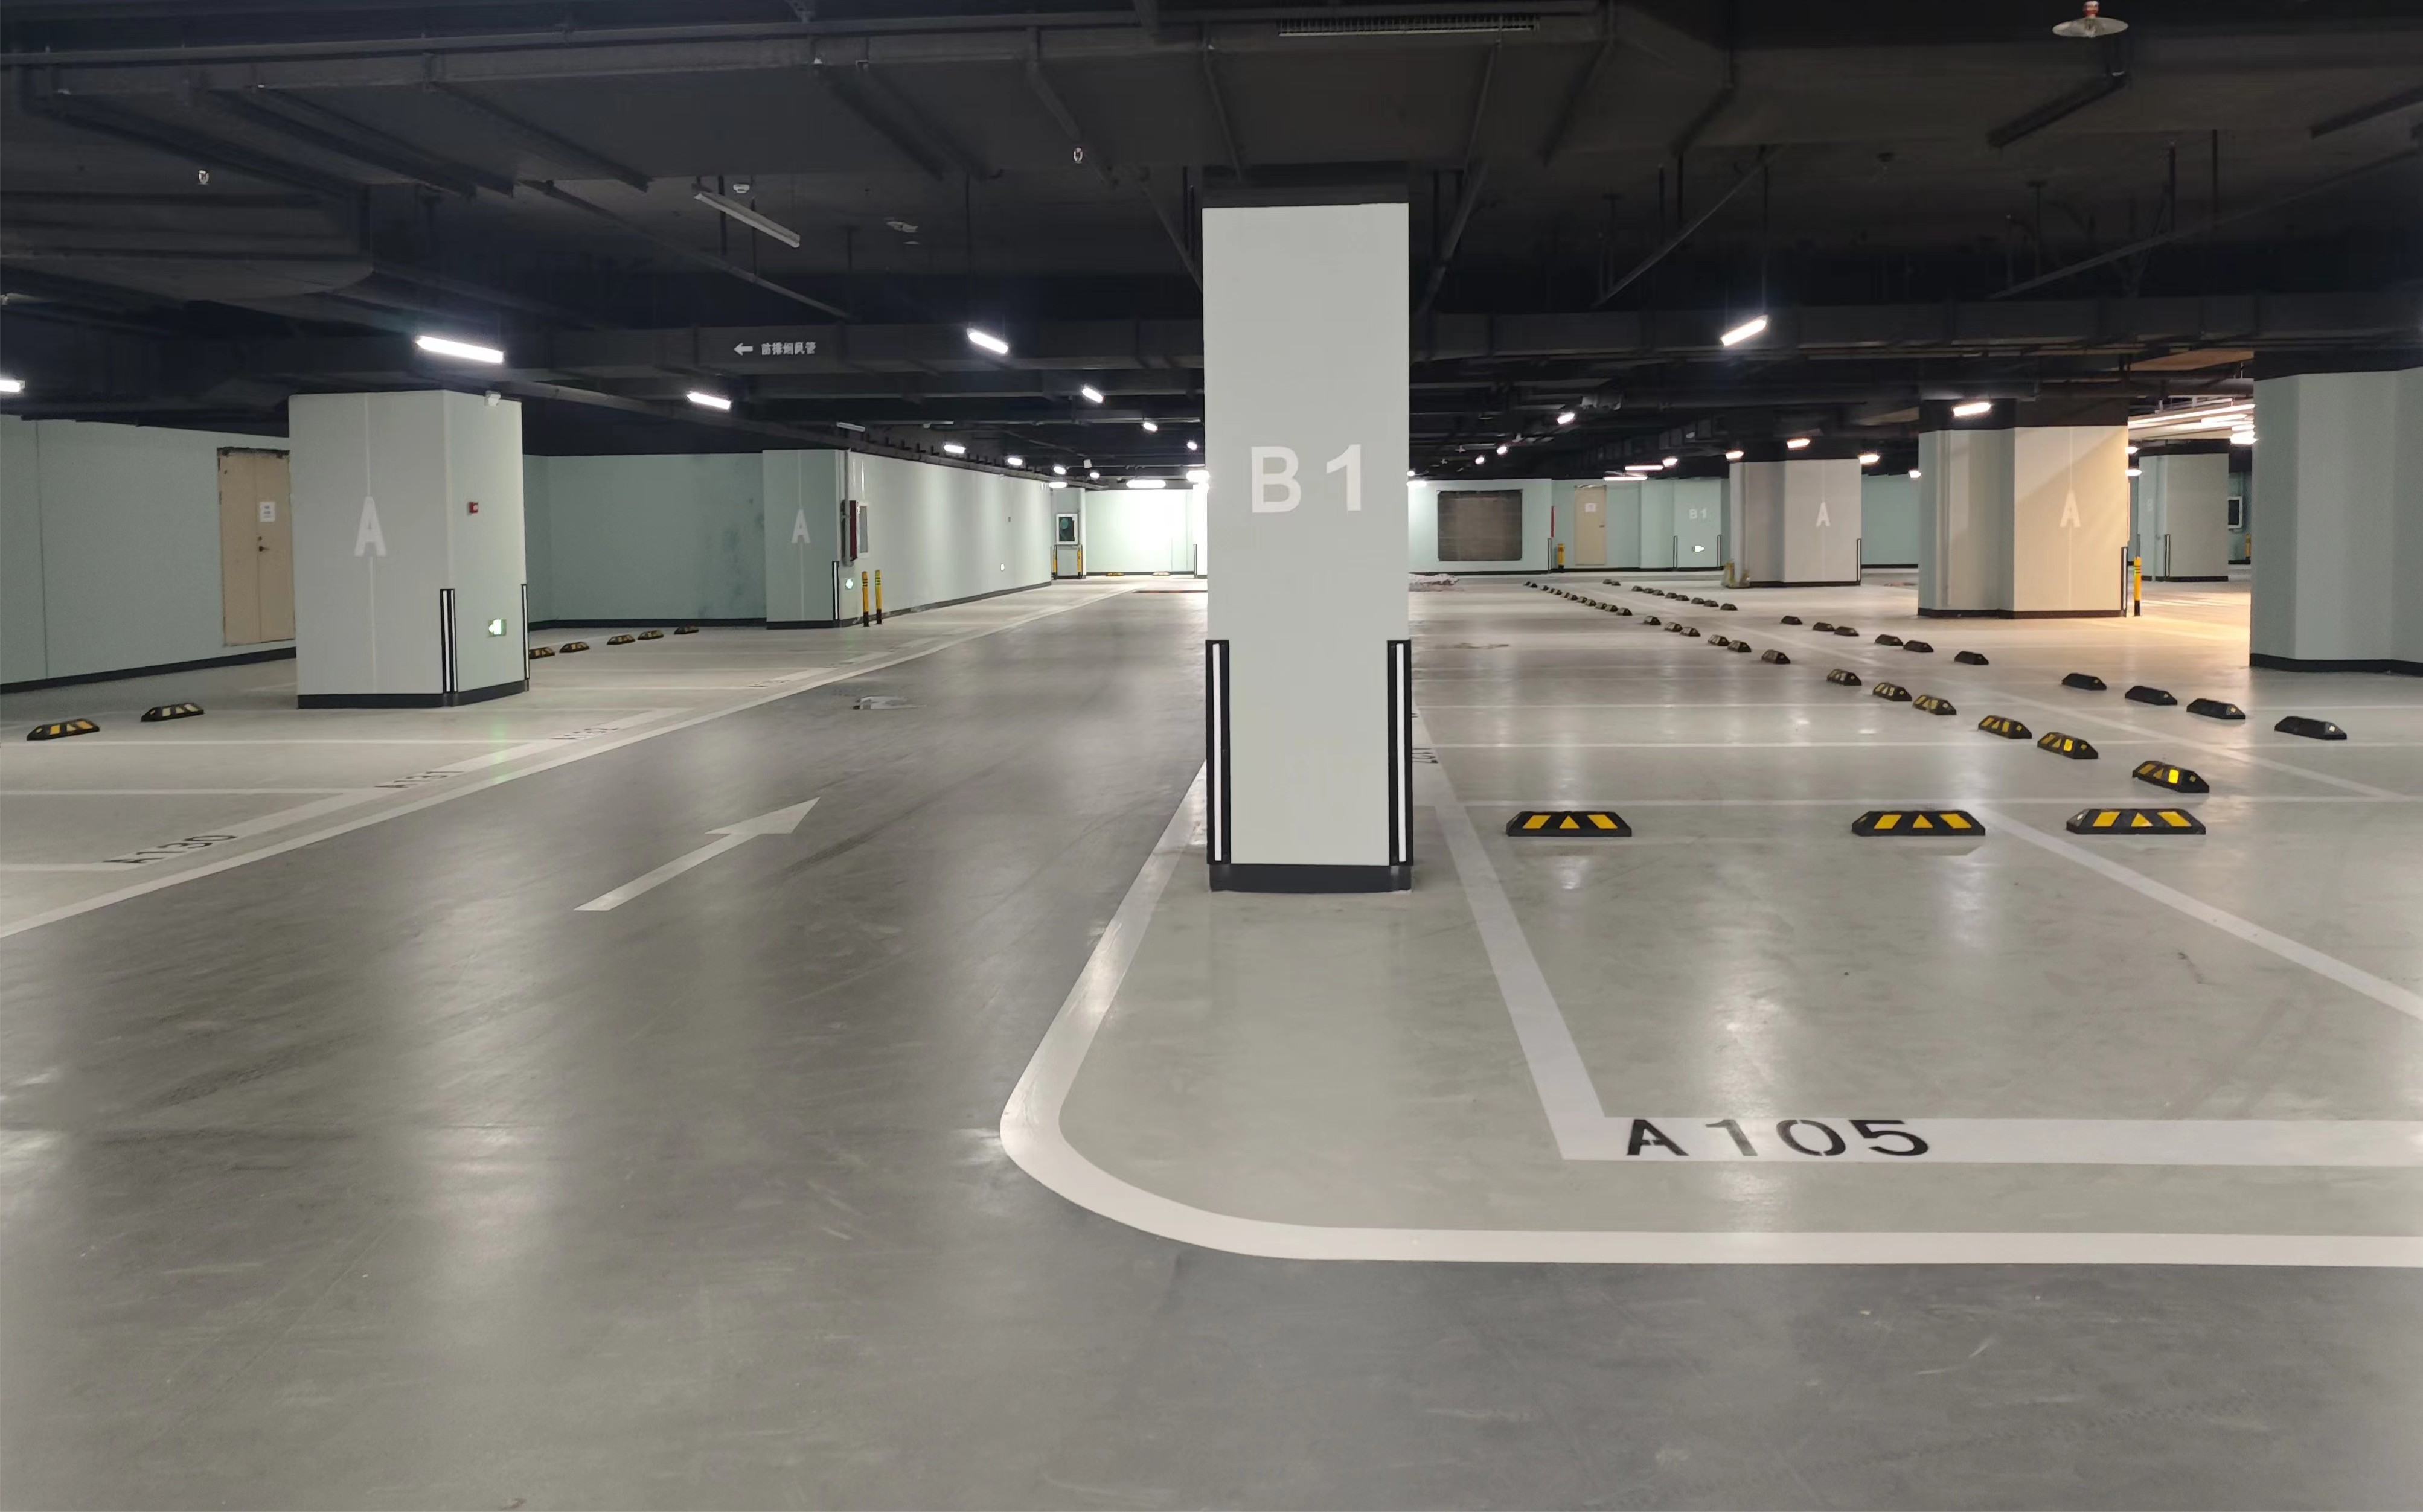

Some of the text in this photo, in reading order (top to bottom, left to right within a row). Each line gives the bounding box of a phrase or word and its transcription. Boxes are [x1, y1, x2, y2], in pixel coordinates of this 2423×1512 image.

[791, 509, 811, 543] A
[1816, 502, 1831, 527] A
[2060, 490, 2081, 528] A
[354, 496, 387, 557] A
[374, 771, 464, 788] A131
[103, 835, 237, 864] A130
[1627, 1120, 1929, 1156] A105
